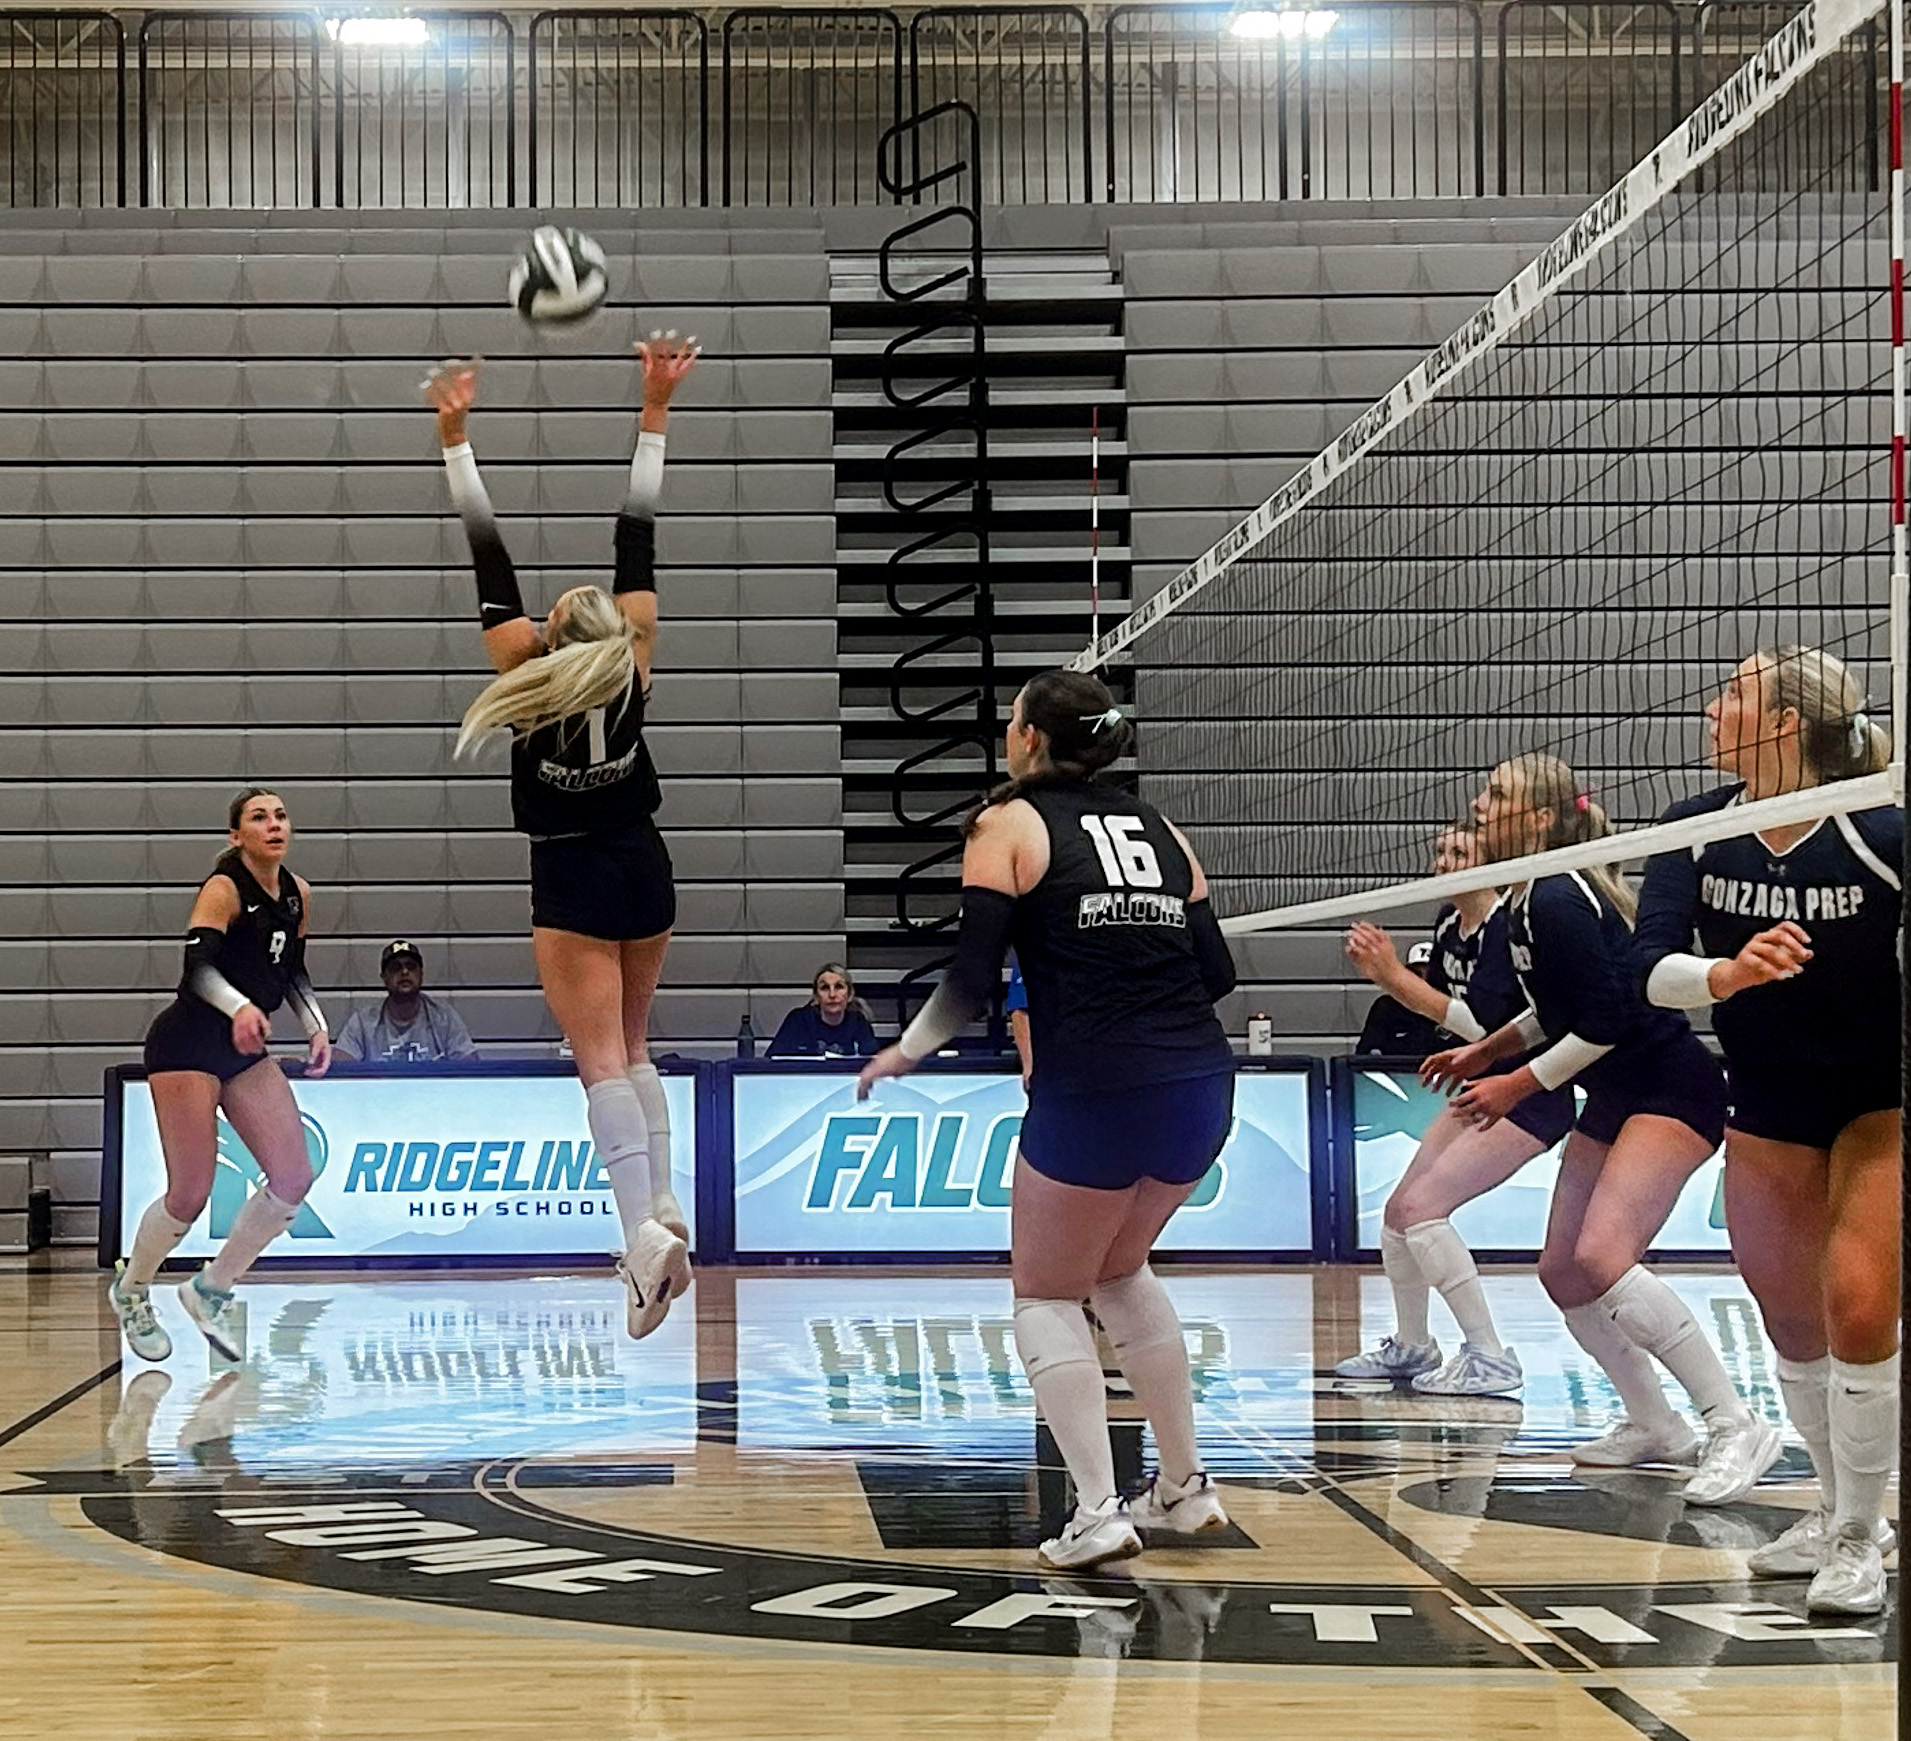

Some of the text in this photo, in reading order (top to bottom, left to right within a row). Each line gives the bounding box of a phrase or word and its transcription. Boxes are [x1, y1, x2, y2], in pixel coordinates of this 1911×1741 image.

[584, 707, 606, 765] 1
[1080, 814, 1163, 888] 16
[1078, 892, 1186, 929] FALCONS
[1701, 873, 1864, 921] GONZAGA PREP
[268, 930, 287, 964] 9
[409, 1201, 613, 1216] HIGH SCHOOL
[213, 1500, 1878, 1643] HOME OF THE
